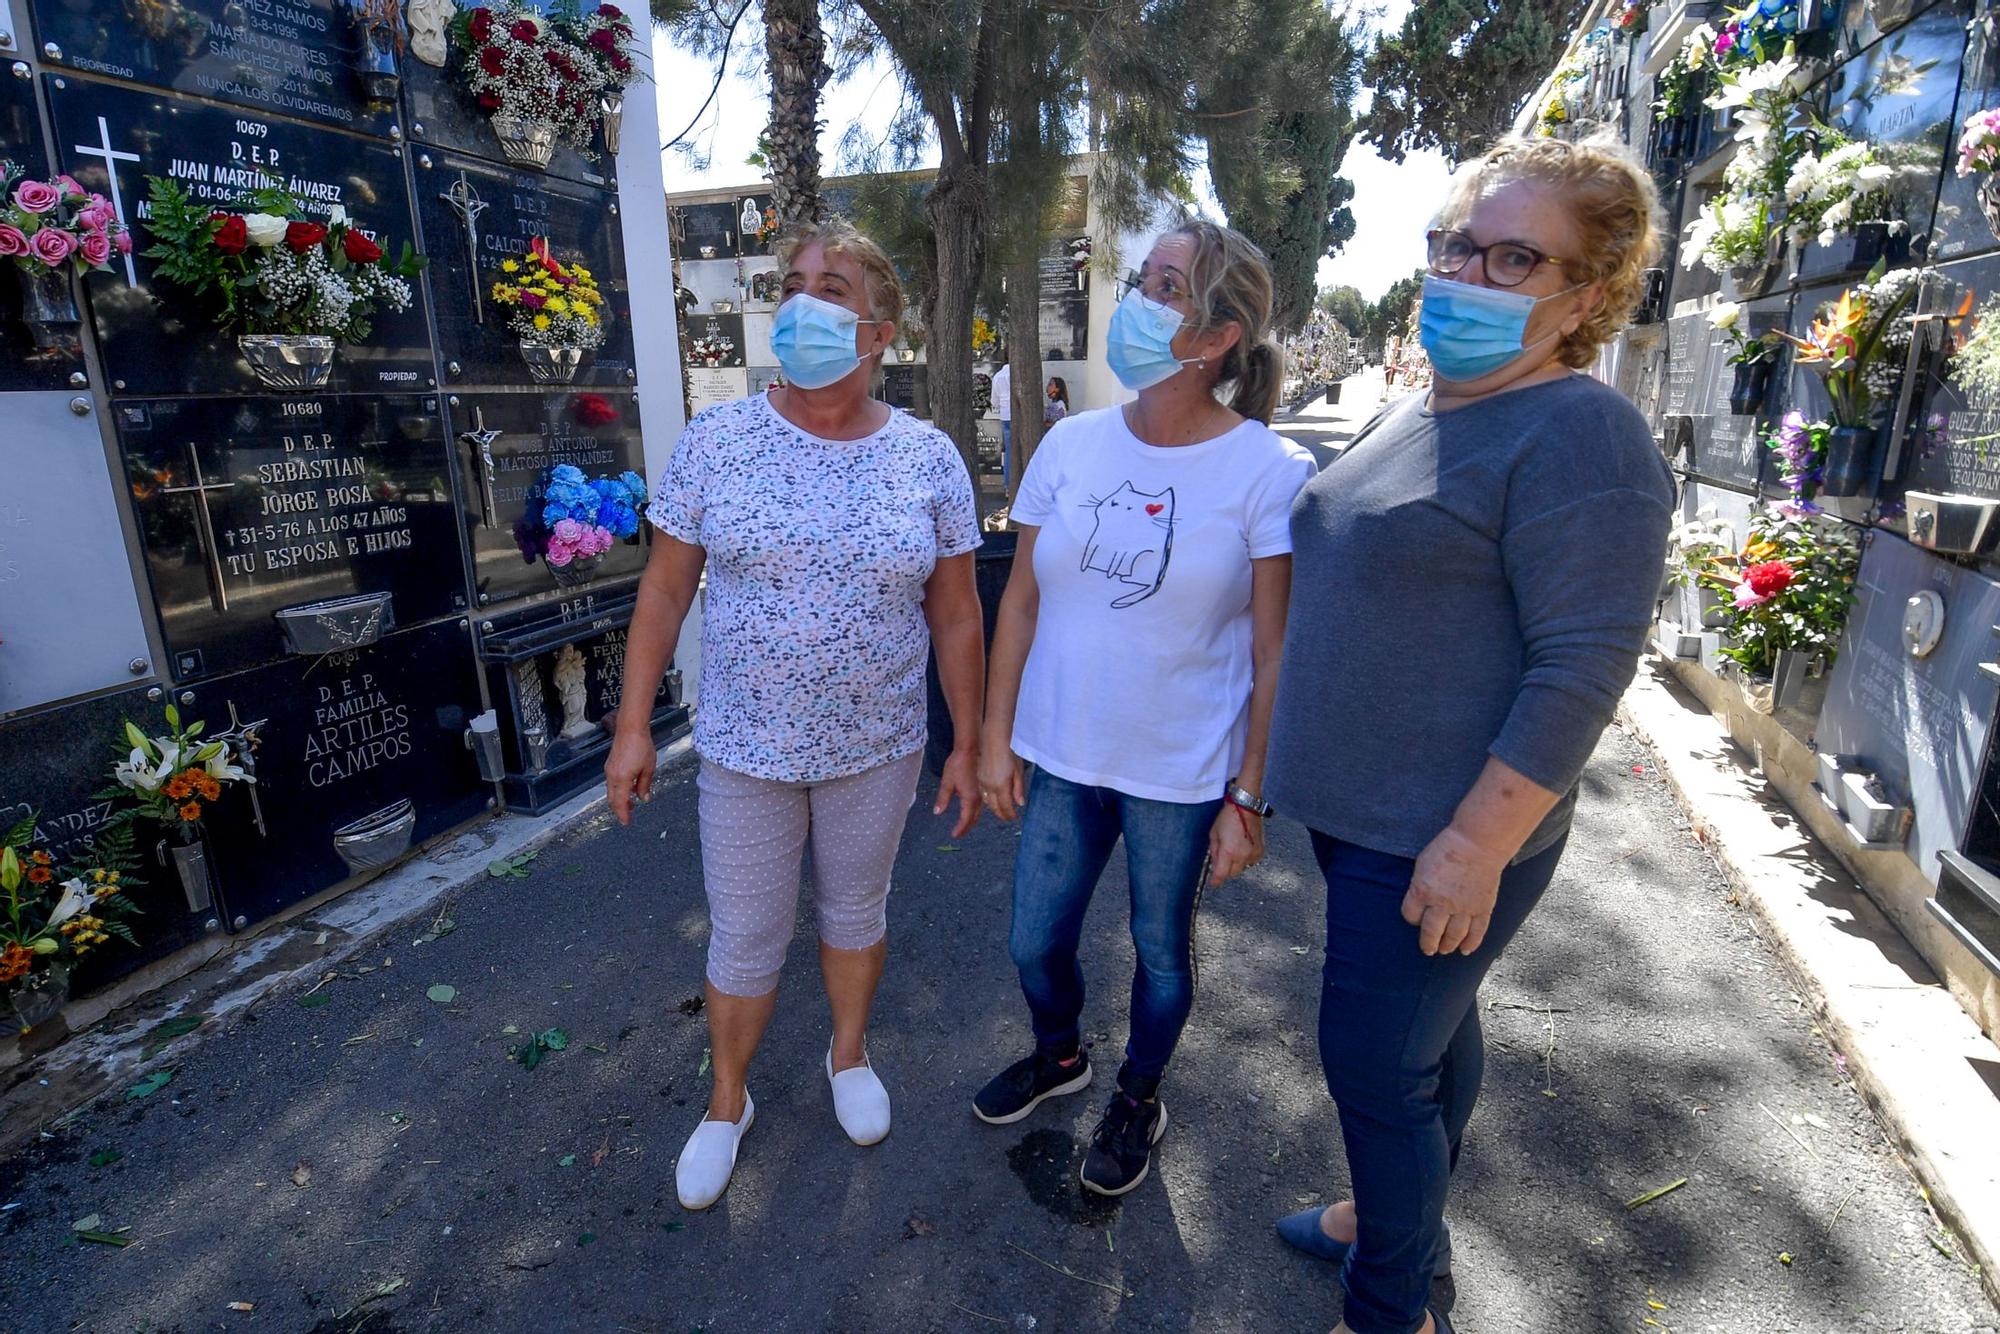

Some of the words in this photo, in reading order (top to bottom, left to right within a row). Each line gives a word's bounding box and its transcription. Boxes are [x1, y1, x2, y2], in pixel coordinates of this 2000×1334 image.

[250, 15, 298, 39] 3-8-1995
[275, 4, 327, 32] RAMOS
[208, 40, 281, 72] SÁNCHEZ
[284, 60, 334, 85] RAMOS
[261, 34, 328, 66] DOLORES
[72, 55, 134, 78] PROPIEDAD
[196, 74, 244, 96] NUNCA
[244, 85, 270, 102] LOS
[272, 92, 353, 122] OLVIDAREMOS
[236, 119, 267, 138] 10679
[168, 158, 208, 181] JUAN
[214, 164, 285, 193] MARTÍNEZ
[289, 174, 341, 202] ÁLVAREZ
[307, 200, 332, 215] AÑOS
[379, 371, 418, 381] PROPIEDAD
[283, 402, 323, 416] 10680
[549, 436, 598, 451] ANTONIO
[259, 456, 366, 485] SEBASTIAN
[500, 456, 548, 472] MATOSO
[552, 450, 614, 467] HERNANDEZ
[261, 491, 319, 516] JORGE
[326, 484, 373, 508] BOSA
[239, 521, 300, 545] 31-5-76
[307, 519, 317, 535] A
[320, 515, 348, 533] LOS
[353, 512, 368, 529] 47
[372, 506, 407, 525] AÑOS
[227, 553, 256, 576] TU
[264, 540, 340, 570] ESPOSA
[346, 536, 359, 556] E
[364, 529, 412, 553] HIJOS
[315, 691, 388, 725] FAMILIA
[304, 704, 409, 762] ARTILES
[309, 732, 411, 787] CAMPOS
